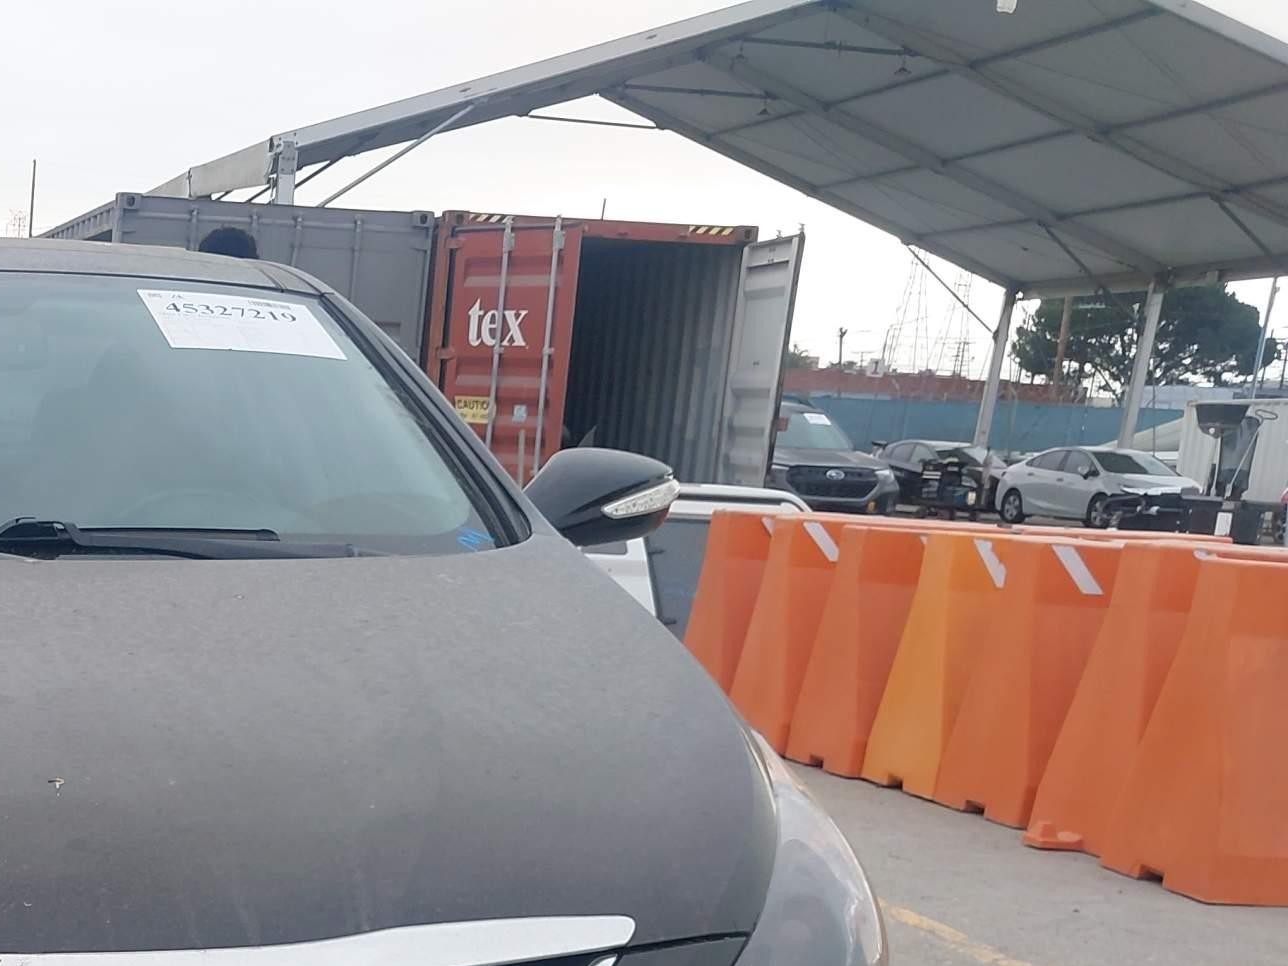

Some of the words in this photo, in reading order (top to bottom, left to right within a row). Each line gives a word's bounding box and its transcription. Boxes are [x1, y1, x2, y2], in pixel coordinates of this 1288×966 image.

[166, 302, 297, 322] 45327219
[468, 297, 529, 347] tex
[456, 399, 489, 410] CAUTIO
